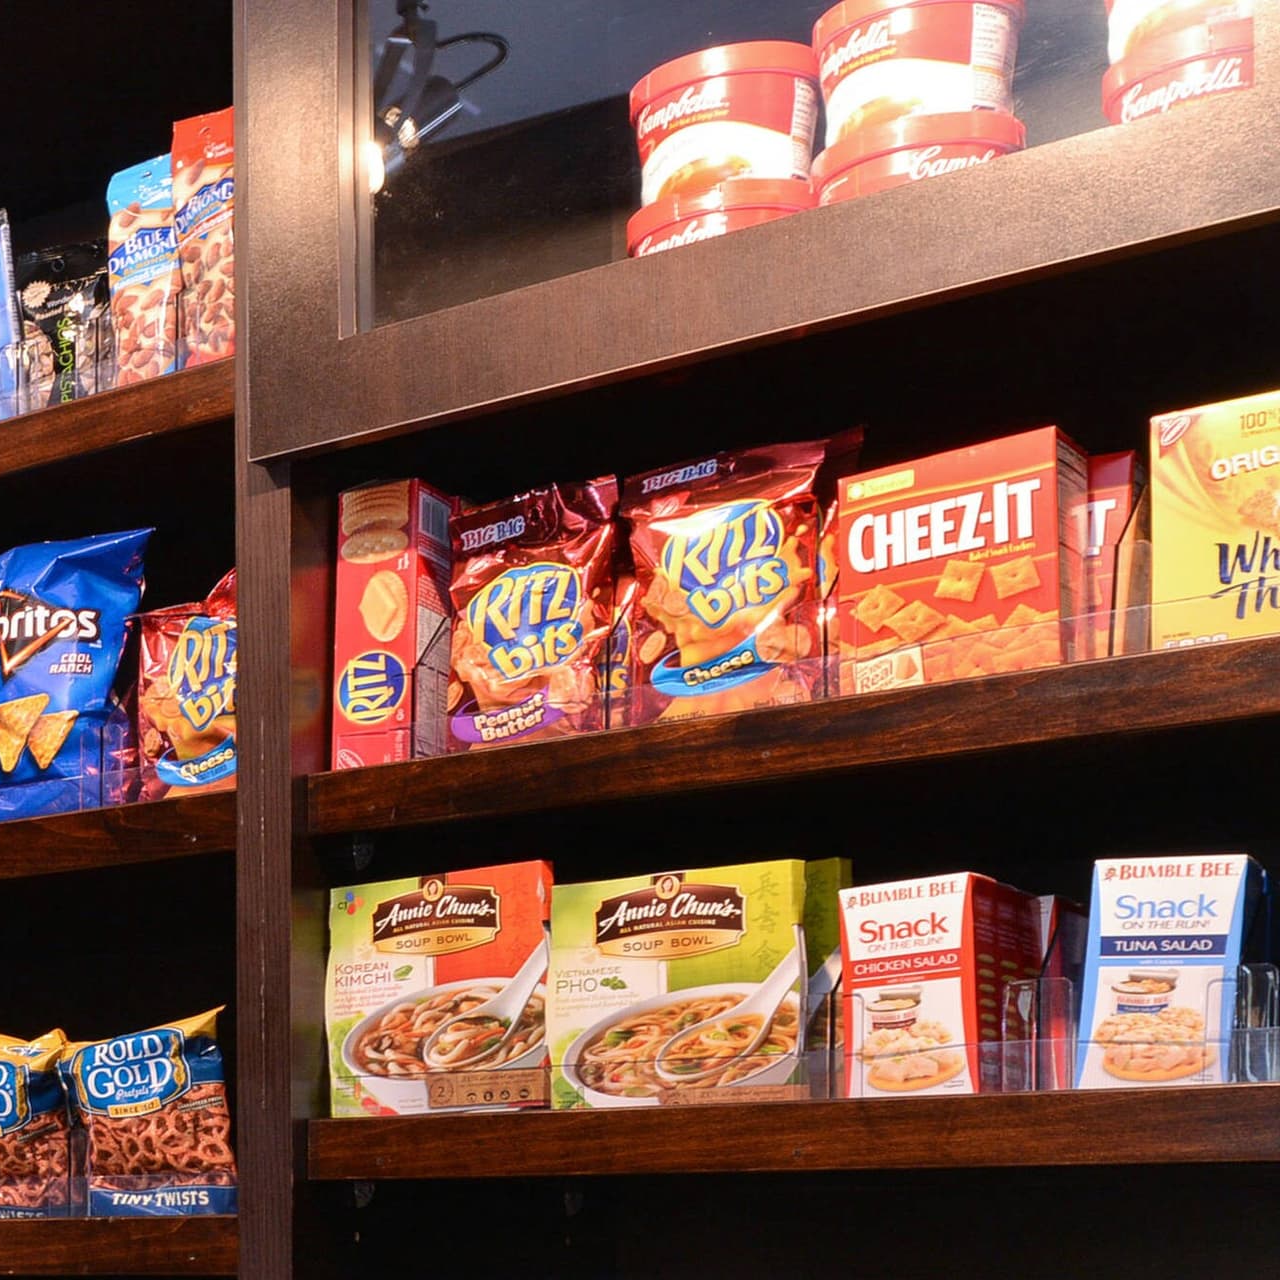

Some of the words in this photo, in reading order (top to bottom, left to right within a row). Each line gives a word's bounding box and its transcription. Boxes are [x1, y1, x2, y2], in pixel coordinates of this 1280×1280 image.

[124, 229, 166, 256] BLUE
[642, 471, 679, 495] BIG
[679, 457, 719, 483] BAG
[462, 528, 492, 550] BIG
[492, 515, 526, 542] BAG
[847, 477, 1041, 575] CHEEZ-IT
[666, 508, 778, 588] RITZ
[472, 566, 575, 644] RITZ
[688, 556, 790, 628] bits
[59, 652, 93, 666] COOL
[490, 620, 583, 681] bits
[48, 661, 93, 675] RANCH
[682, 648, 756, 688] Cheese
[346, 654, 390, 722] RITZ
[473, 691, 545, 732] Peanut
[481, 706, 547, 742] Butter
[1118, 861, 1193, 881] BUMBLE
[1199, 859, 1239, 879] BEE
[858, 885, 927, 908] BUMBLE
[928, 881, 961, 898] BEE
[1114, 893, 1218, 921] Snack
[376, 900, 433, 932] Annie
[434, 893, 498, 920] Chun's
[598, 901, 663, 934] Annie
[663, 893, 742, 918] Chun's
[1121, 920, 1142, 931] ON
[1144, 919, 1168, 930] THE
[404, 921, 430, 932] NATURAL
[632, 922, 661, 933] NATURAL
[858, 912, 949, 945] Snack
[395, 937, 432, 950] SOUP
[435, 932, 474, 947] BOWL
[622, 940, 666, 953] SOUP
[670, 935, 714, 949] BOWL
[867, 940, 885, 953] ON
[886, 938, 910, 951] THE
[1114, 939, 1158, 953] TUNA
[1160, 938, 1213, 952] SALAD
[334, 961, 389, 974] KOREAN
[555, 966, 622, 978] VIETNAMESE
[854, 958, 911, 976] CHICKEN
[912, 951, 959, 968] SALAD
[334, 971, 392, 988] KIMCHI
[555, 977, 598, 995] PHO
[92, 1033, 162, 1068] ROLD
[86, 1056, 173, 1100] GOLD
[111, 1192, 152, 1206] TINY
[155, 1190, 210, 1207] TWISTS
